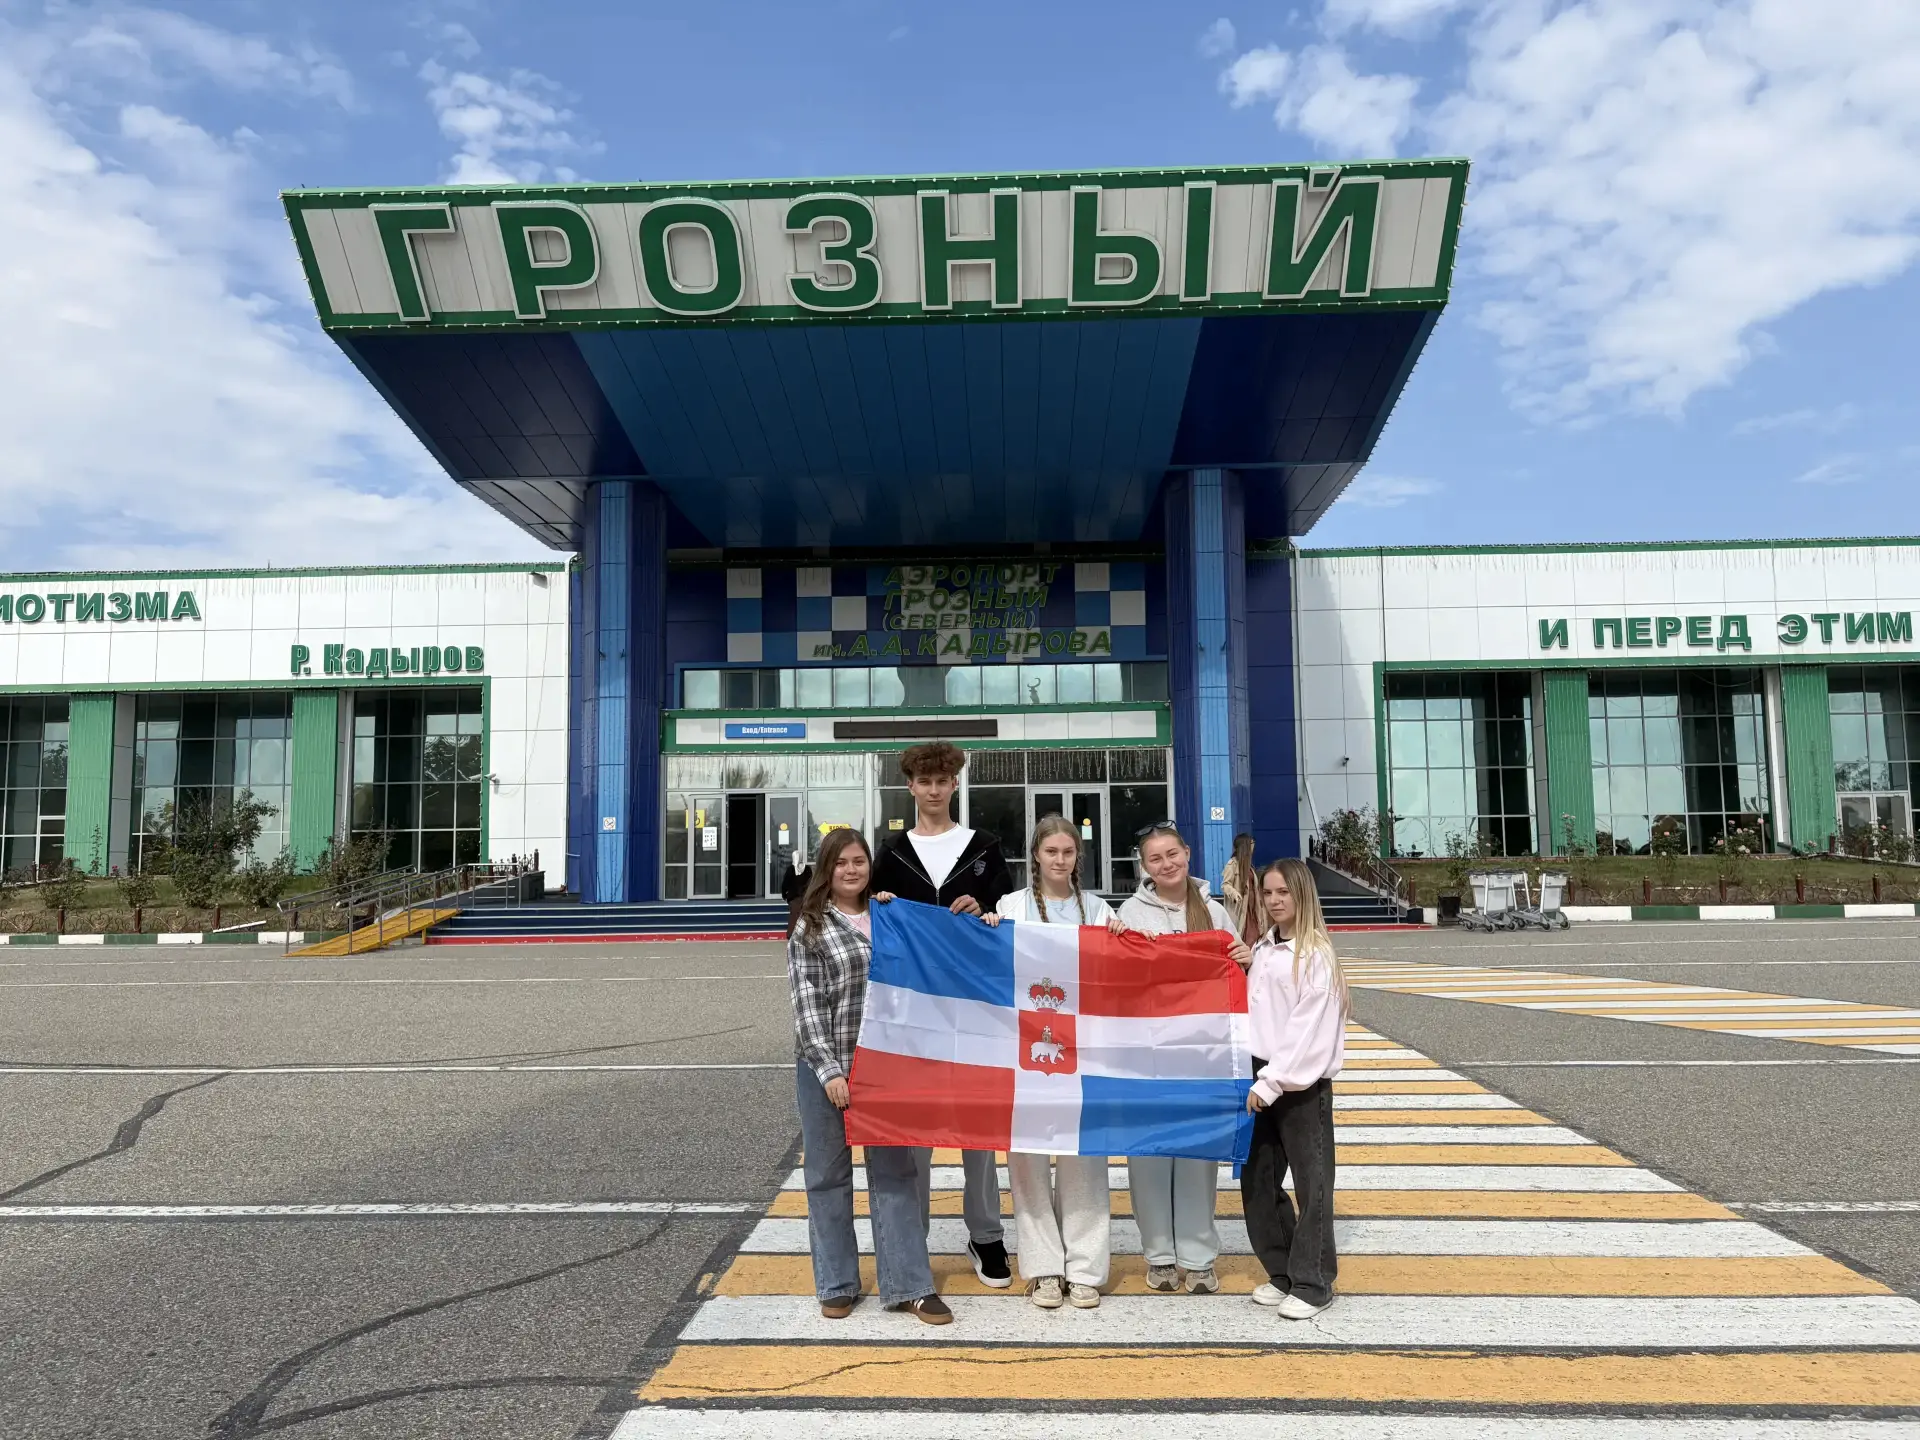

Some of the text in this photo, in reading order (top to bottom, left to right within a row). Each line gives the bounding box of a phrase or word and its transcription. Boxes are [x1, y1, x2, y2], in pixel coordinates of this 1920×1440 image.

[370, 167, 1385, 321] ГРОЗНЫЙ
[884, 564, 1062, 586] АЭРОПОРТ
[883, 583, 1049, 611] ГРОЗНЫЙ
[882, 608, 1036, 631] (СЕВЕРНЫЙ)
[1538, 612, 1914, 651] И ПЕРЕД ЭТИМ
[917, 631, 1111, 658] КАДЫРОВА
[291, 643, 485, 679] Р. Кадыров
